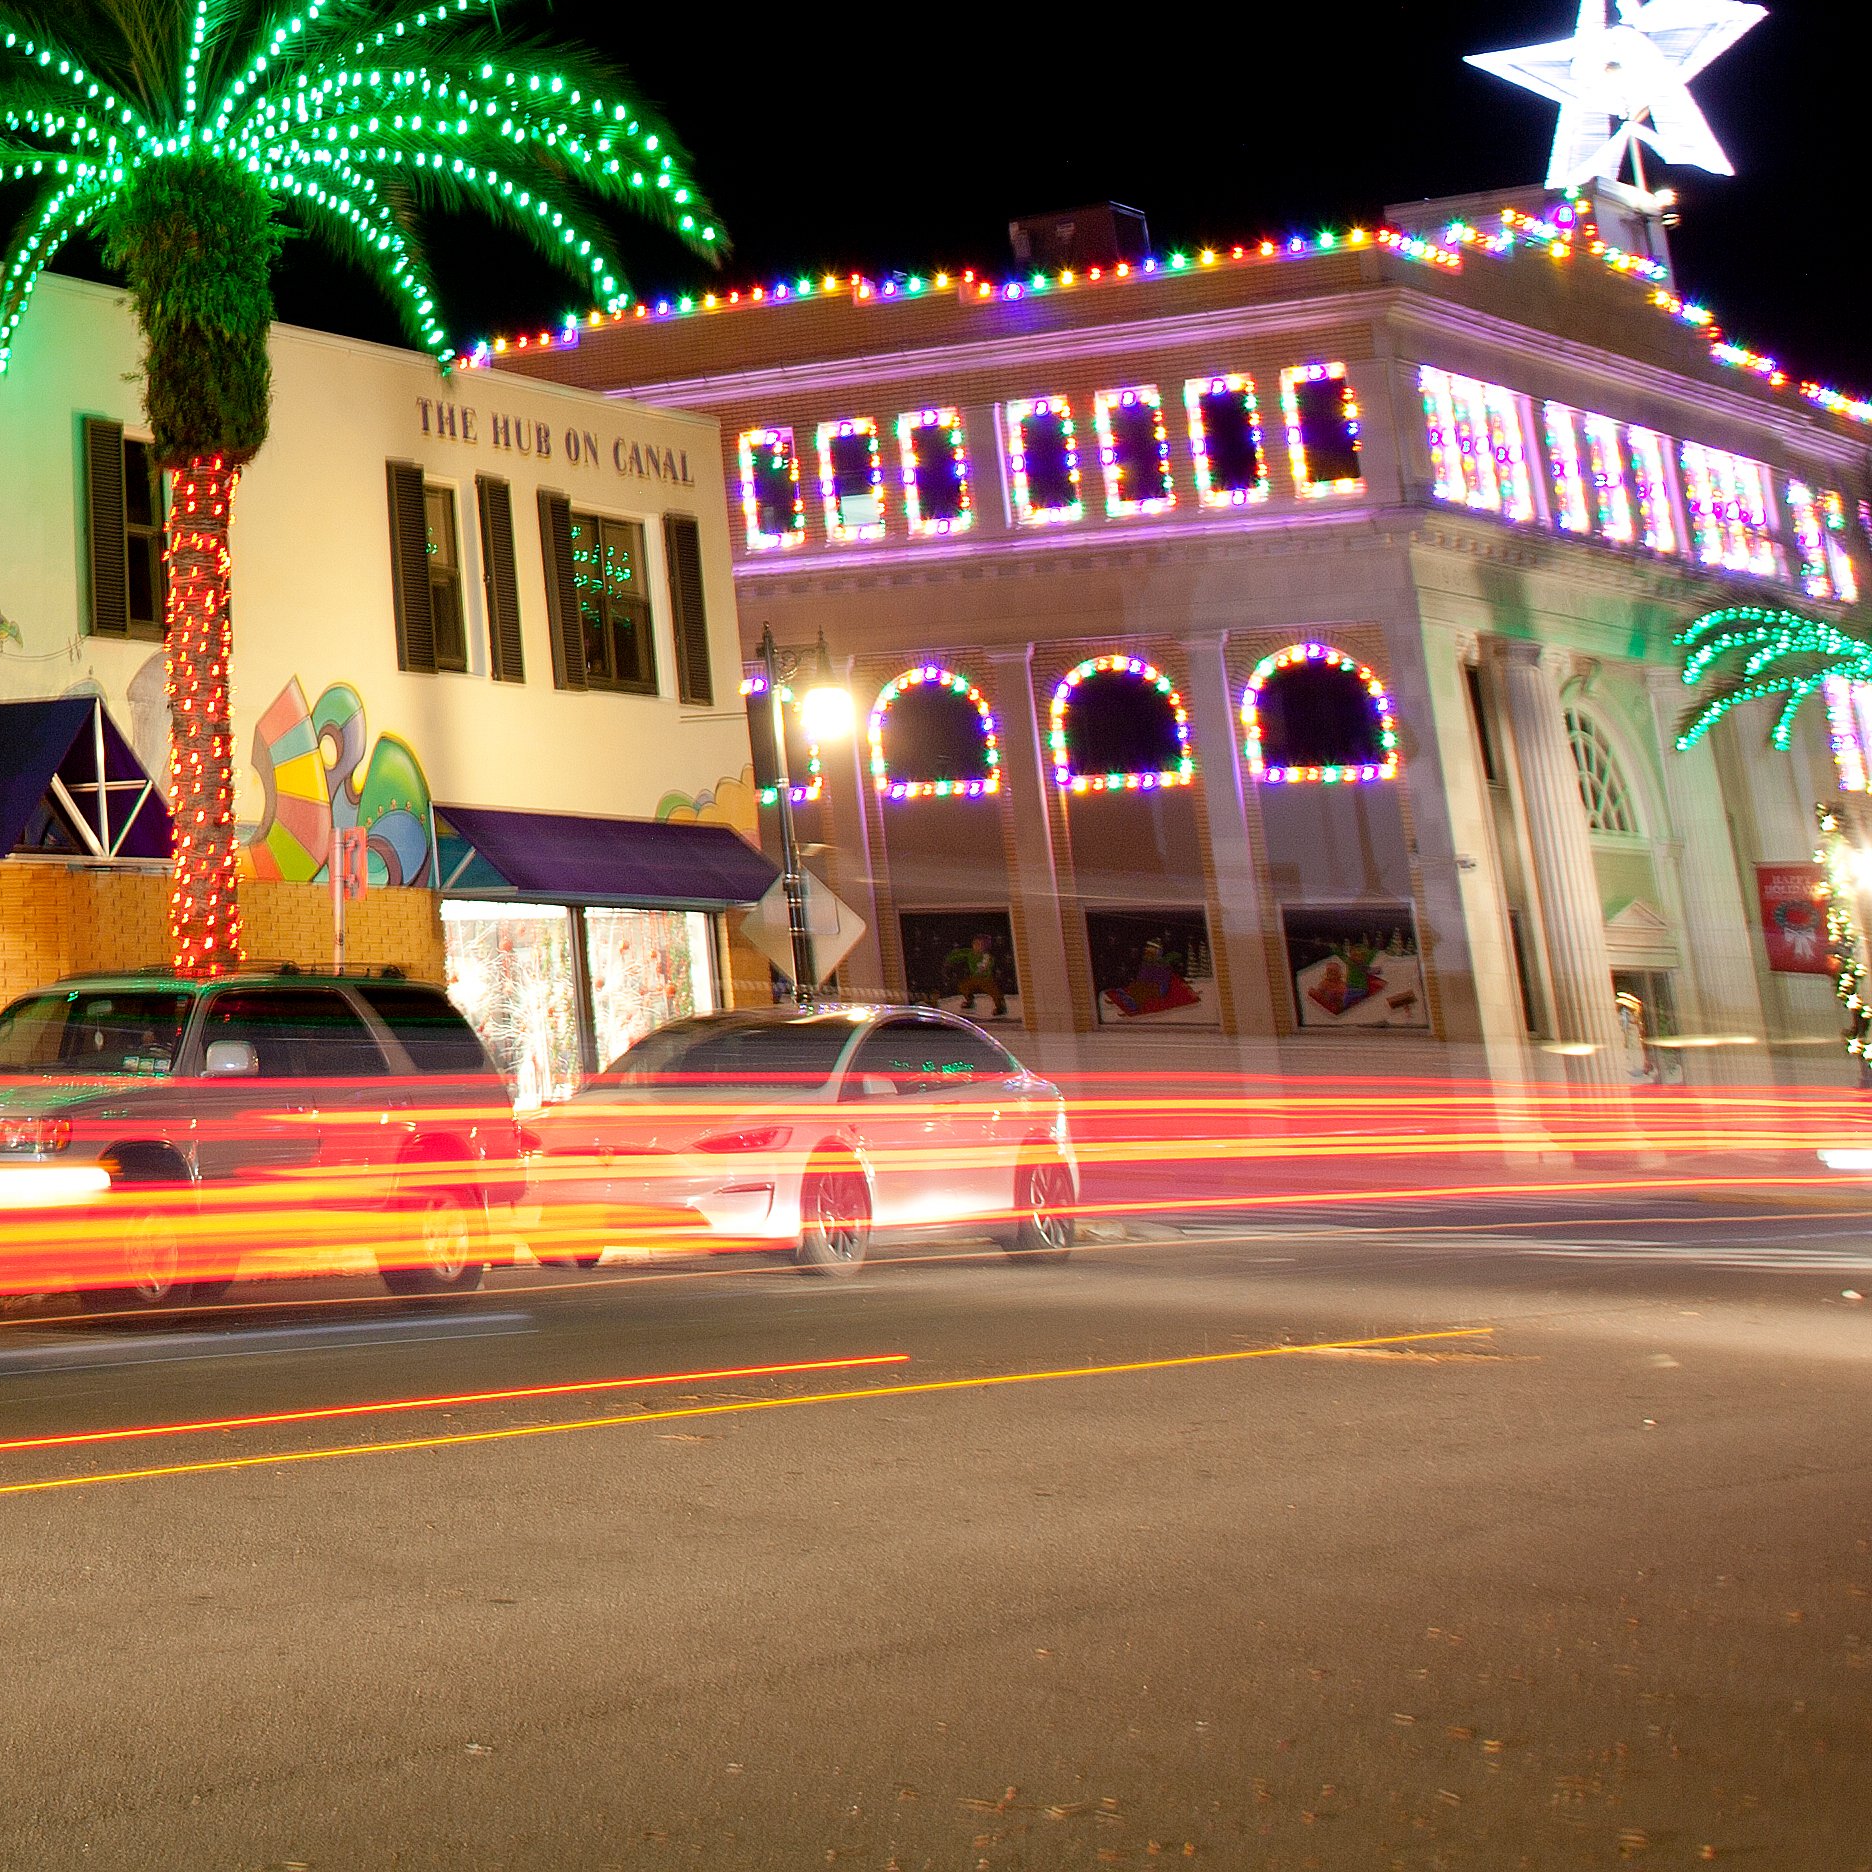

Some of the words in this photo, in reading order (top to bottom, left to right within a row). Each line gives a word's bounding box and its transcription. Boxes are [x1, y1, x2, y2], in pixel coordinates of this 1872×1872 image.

[416, 396, 478, 444] THE
[492, 411, 552, 459] HUB
[564, 426, 599, 467] ON
[612, 436, 696, 487] CANAL
